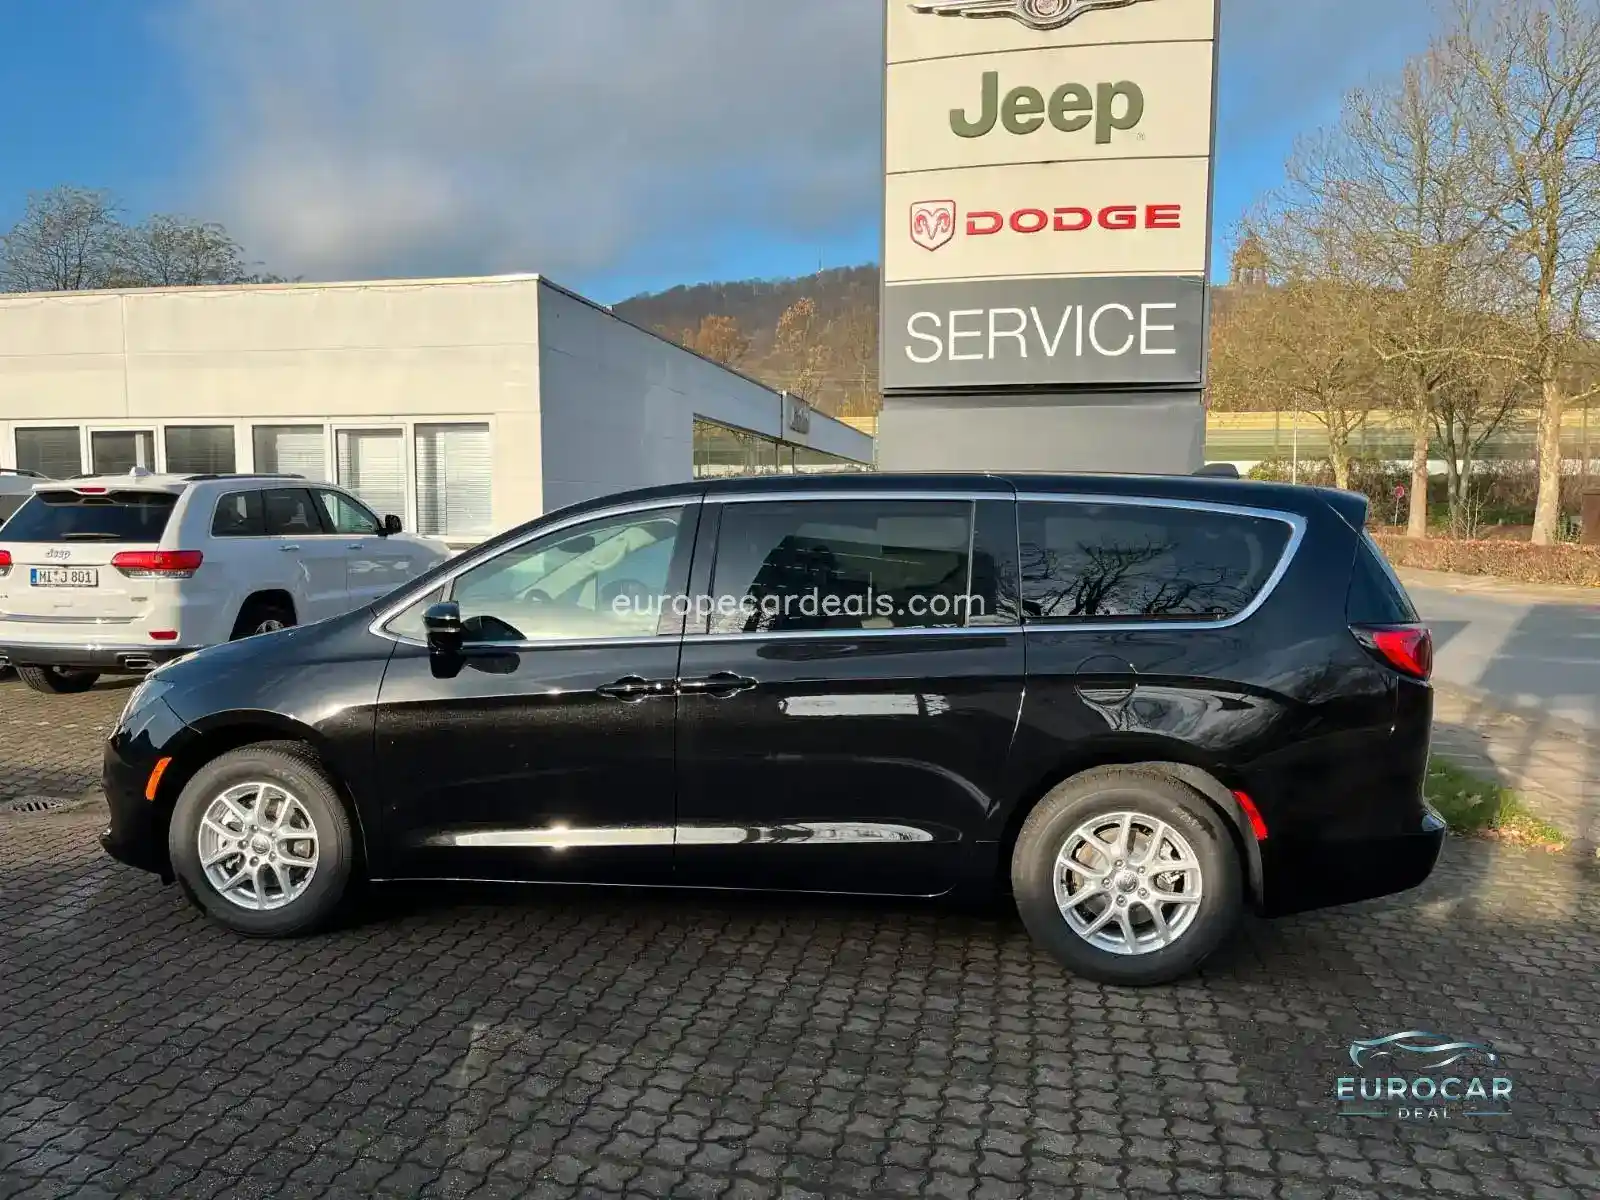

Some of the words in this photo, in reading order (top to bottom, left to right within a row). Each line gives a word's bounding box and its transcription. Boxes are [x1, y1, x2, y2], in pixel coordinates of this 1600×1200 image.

[949, 71, 1145, 145] Jeep
[965, 204, 1182, 236] DODGE
[904, 302, 1178, 364] SERVICE
